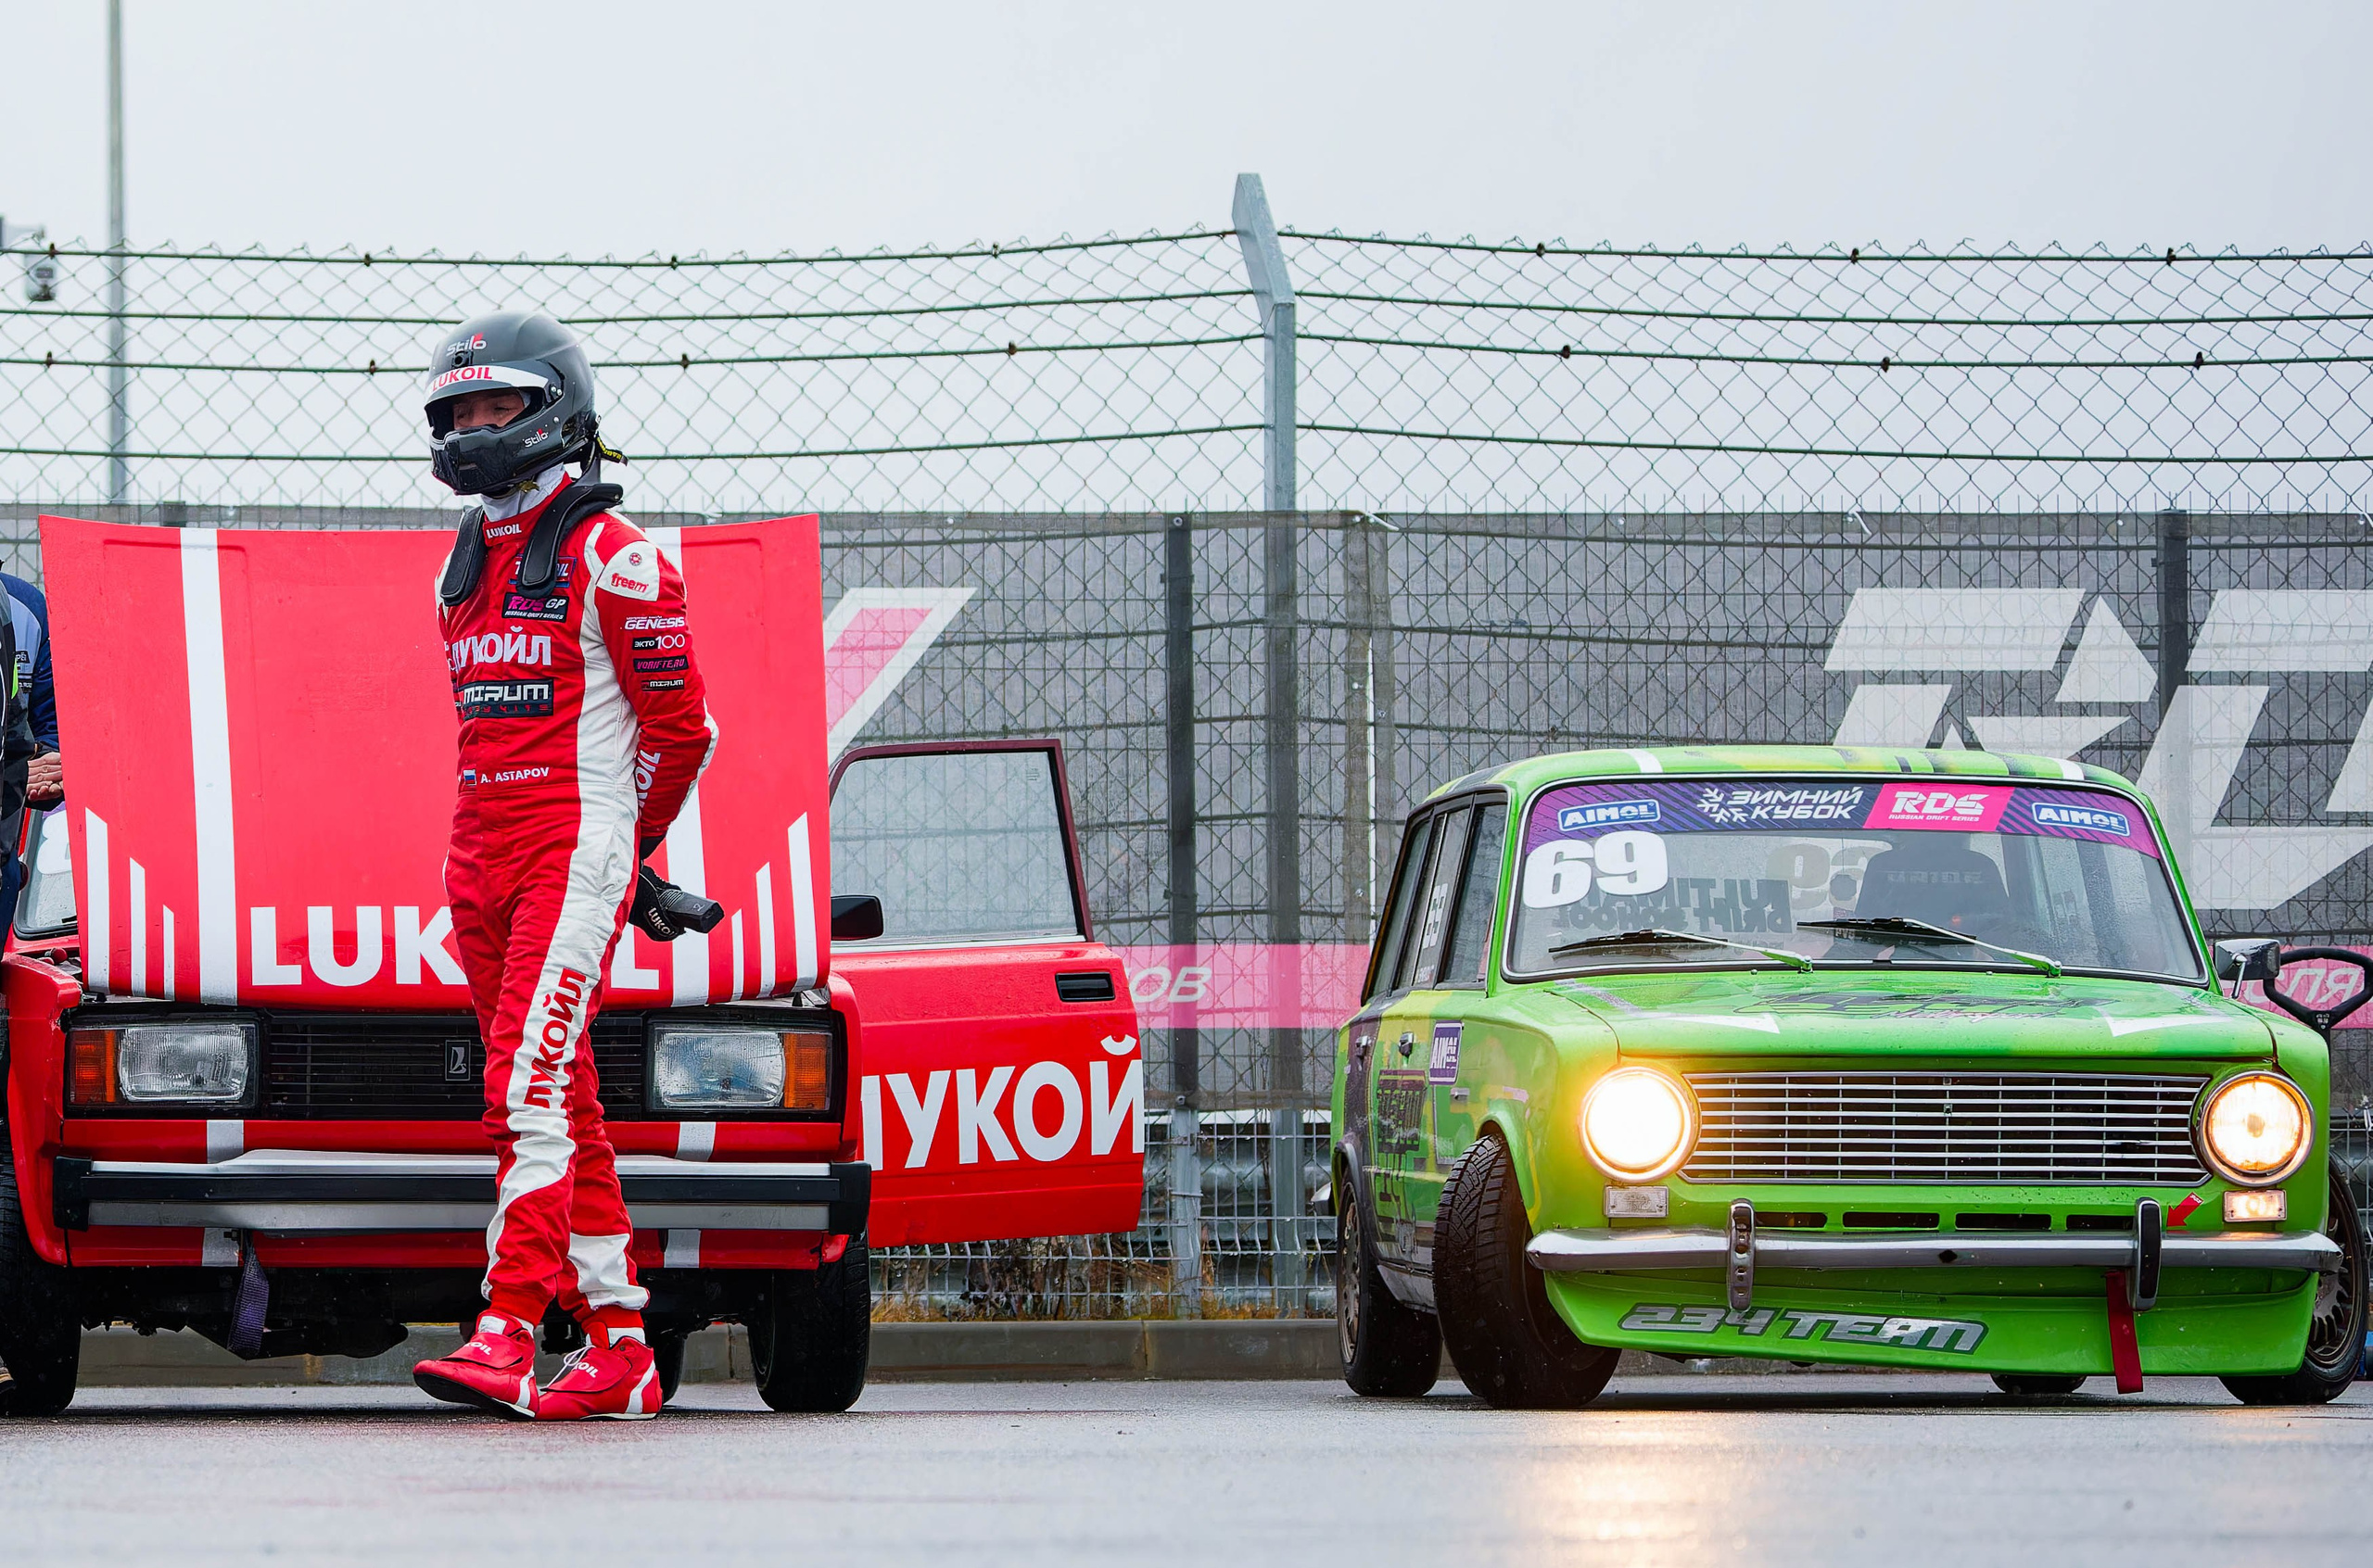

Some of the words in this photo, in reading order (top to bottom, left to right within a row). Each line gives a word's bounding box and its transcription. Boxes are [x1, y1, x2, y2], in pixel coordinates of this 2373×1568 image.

[432, 367, 492, 391] LUKOIL
[486, 524, 522, 539] LUKOIL
[611, 573, 648, 593] freem
[545, 598, 566, 609] GP
[625, 616, 685, 630] GENESIS
[451, 626, 552, 674] ЛУКОЙЛ
[480, 775, 491, 783] A.
[495, 767, 550, 782] ASTAPOV
[1727, 786, 1864, 804] ЗИМНИЙ
[1891, 790, 1989, 816] RDS
[1564, 802, 1656, 827] AIMOL
[1750, 804, 1857, 819] КУБОК
[2038, 807, 2125, 831] AIMOL
[1522, 830, 1669, 909] 69
[250, 905, 660, 991] LUKL
[1125, 967, 1212, 1003] ОВ
[524, 967, 587, 1108] ЛУКОЙЛ
[1620, 1304, 1775, 1335] 234
[1782, 1309, 1987, 1354] TEAM
